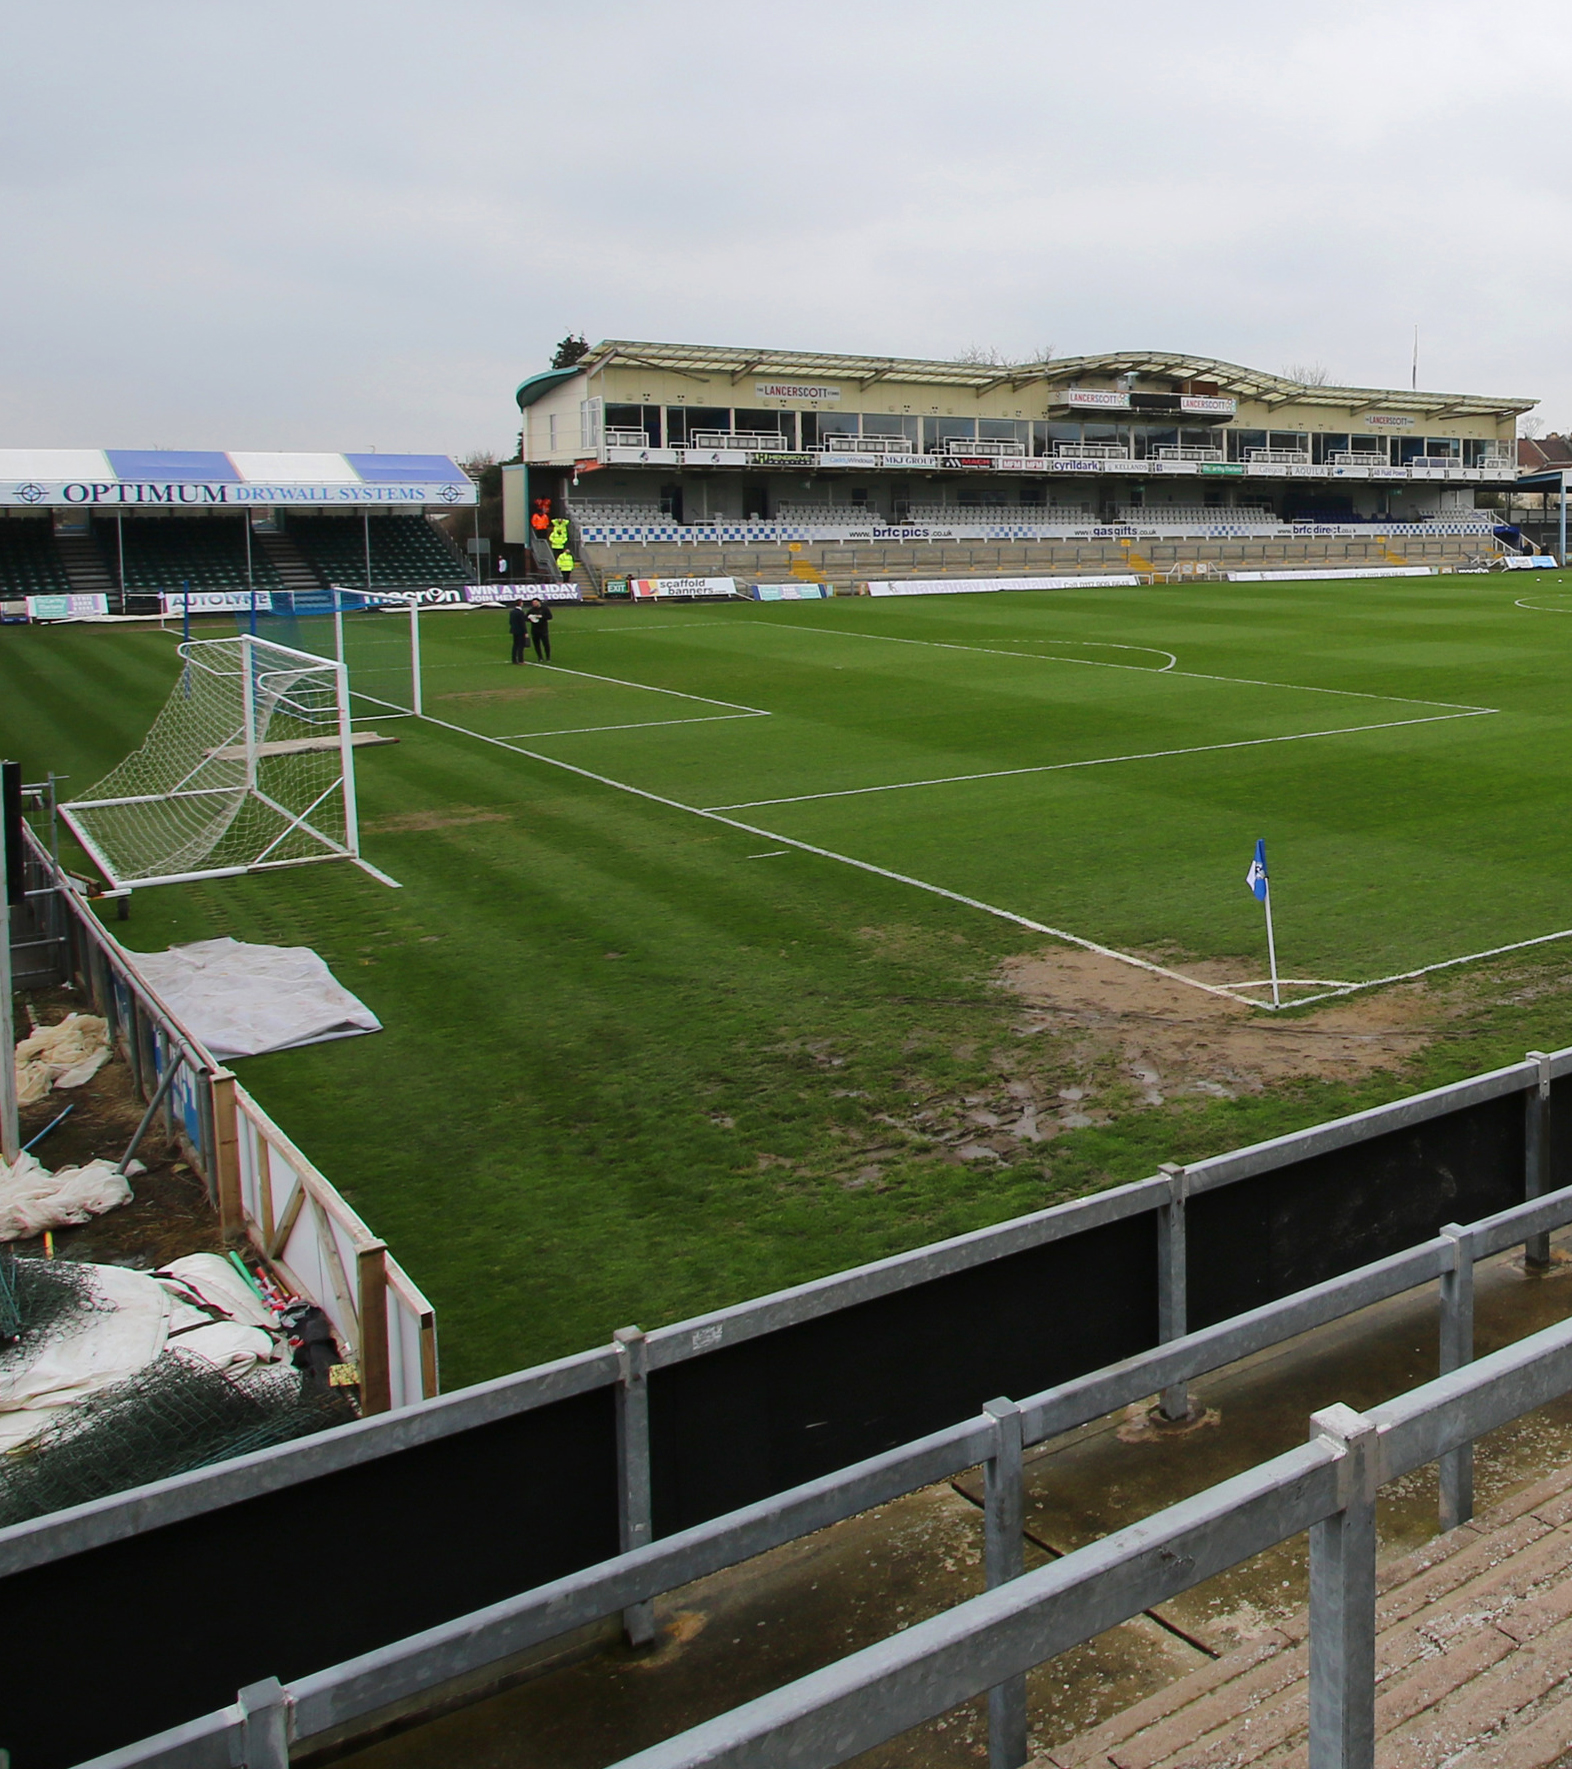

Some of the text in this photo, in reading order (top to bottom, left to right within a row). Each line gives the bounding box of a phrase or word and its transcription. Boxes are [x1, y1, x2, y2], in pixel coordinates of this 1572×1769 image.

[764, 385, 827, 398] LANCERSCOTT
[1070, 392, 1117, 404] LANCERSCOTT
[1182, 399, 1225, 410] LANCERSCOTT
[885, 456, 935, 465] MKJ GROUP
[1054, 460, 1098, 471] cyrildark
[63, 483, 426, 503] OPTIMUM DRYWALL SYSTEMS
[468, 583, 578, 595] WIN A HOLIDAY
[660, 579, 706, 589] scaffold
[469, 592, 579, 603] JOIN HELPLINE TODAY
